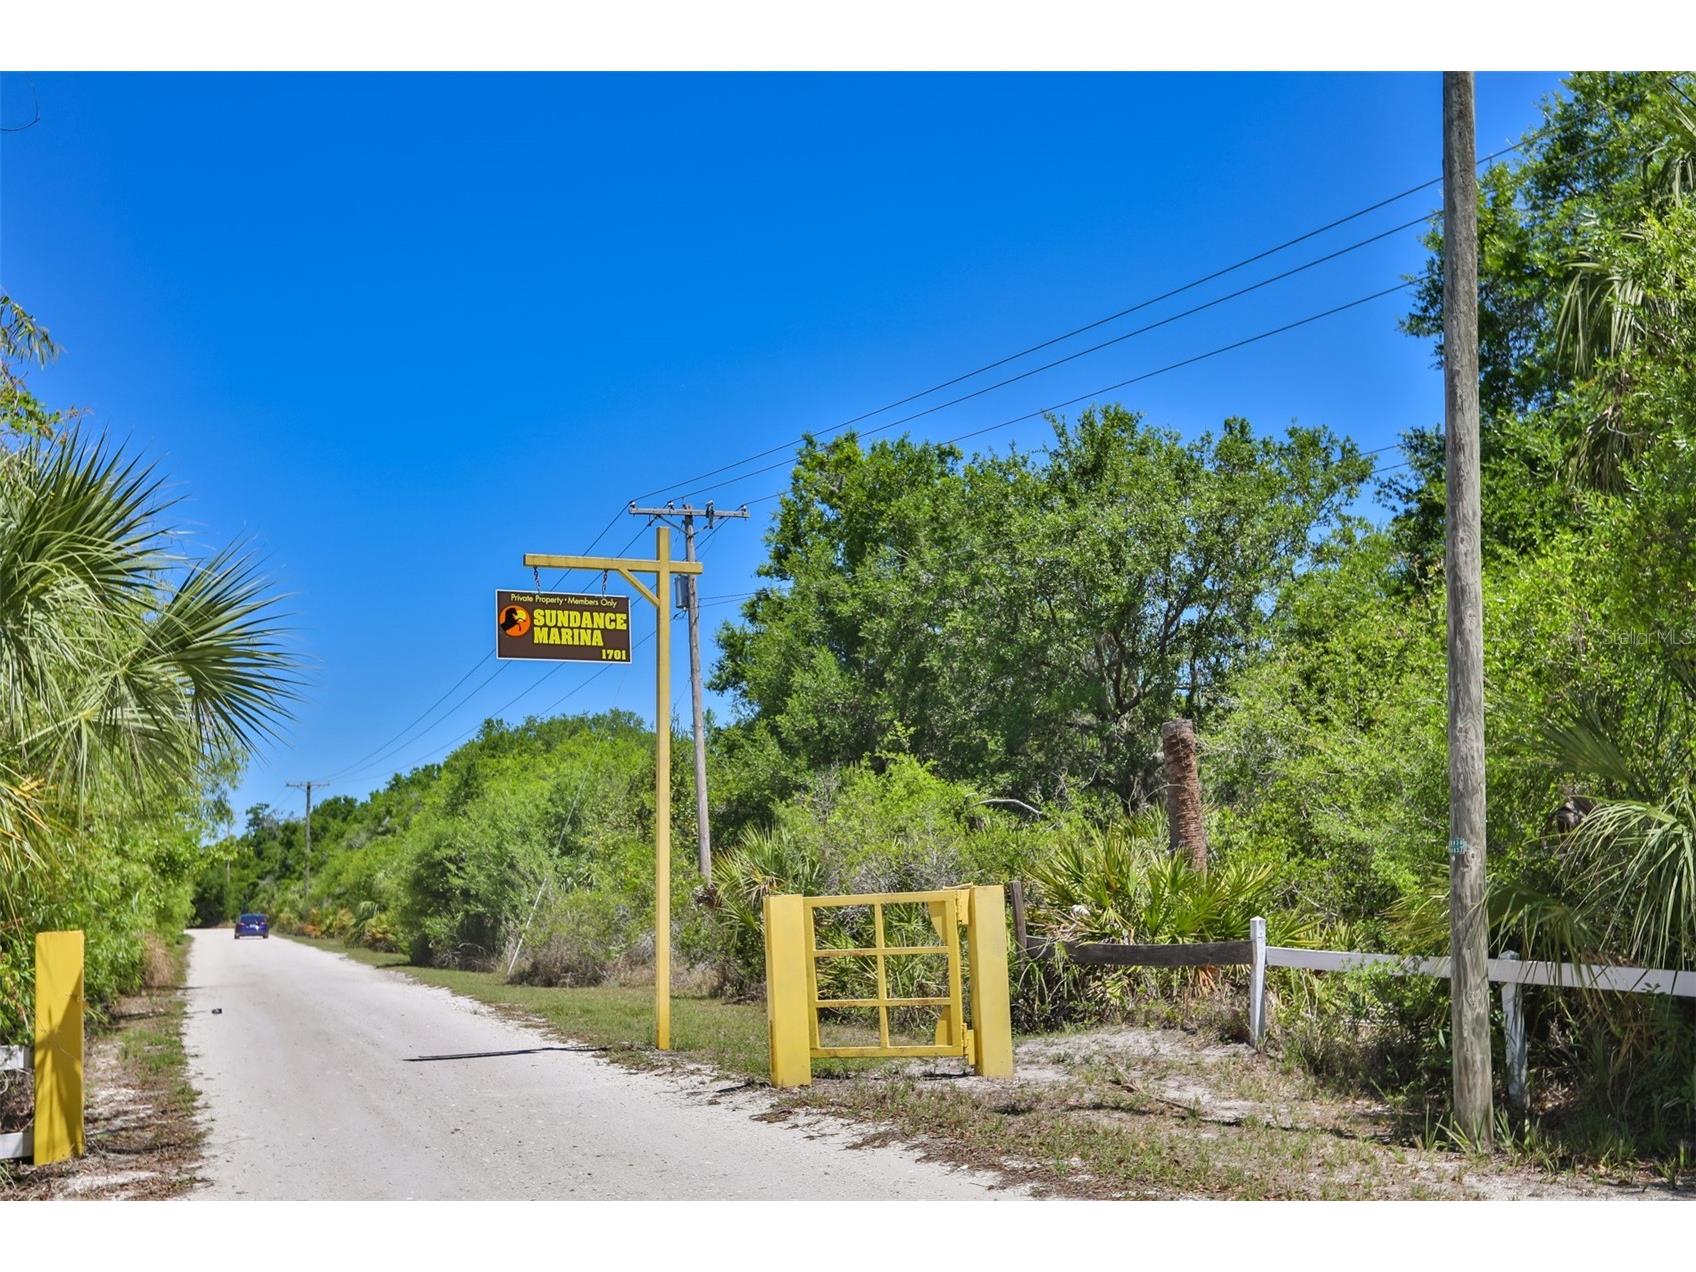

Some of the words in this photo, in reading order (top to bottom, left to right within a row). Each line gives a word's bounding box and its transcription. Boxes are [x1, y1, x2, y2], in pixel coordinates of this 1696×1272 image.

[510, 593, 534, 602] Private
[535, 594, 563, 606] Property
[567, 596, 599, 606] Members
[600, 598, 617, 609] Only
[533, 608, 627, 630] SUNDANCE
[533, 626, 604, 646] MARINA
[601, 649, 627, 660] 1701
